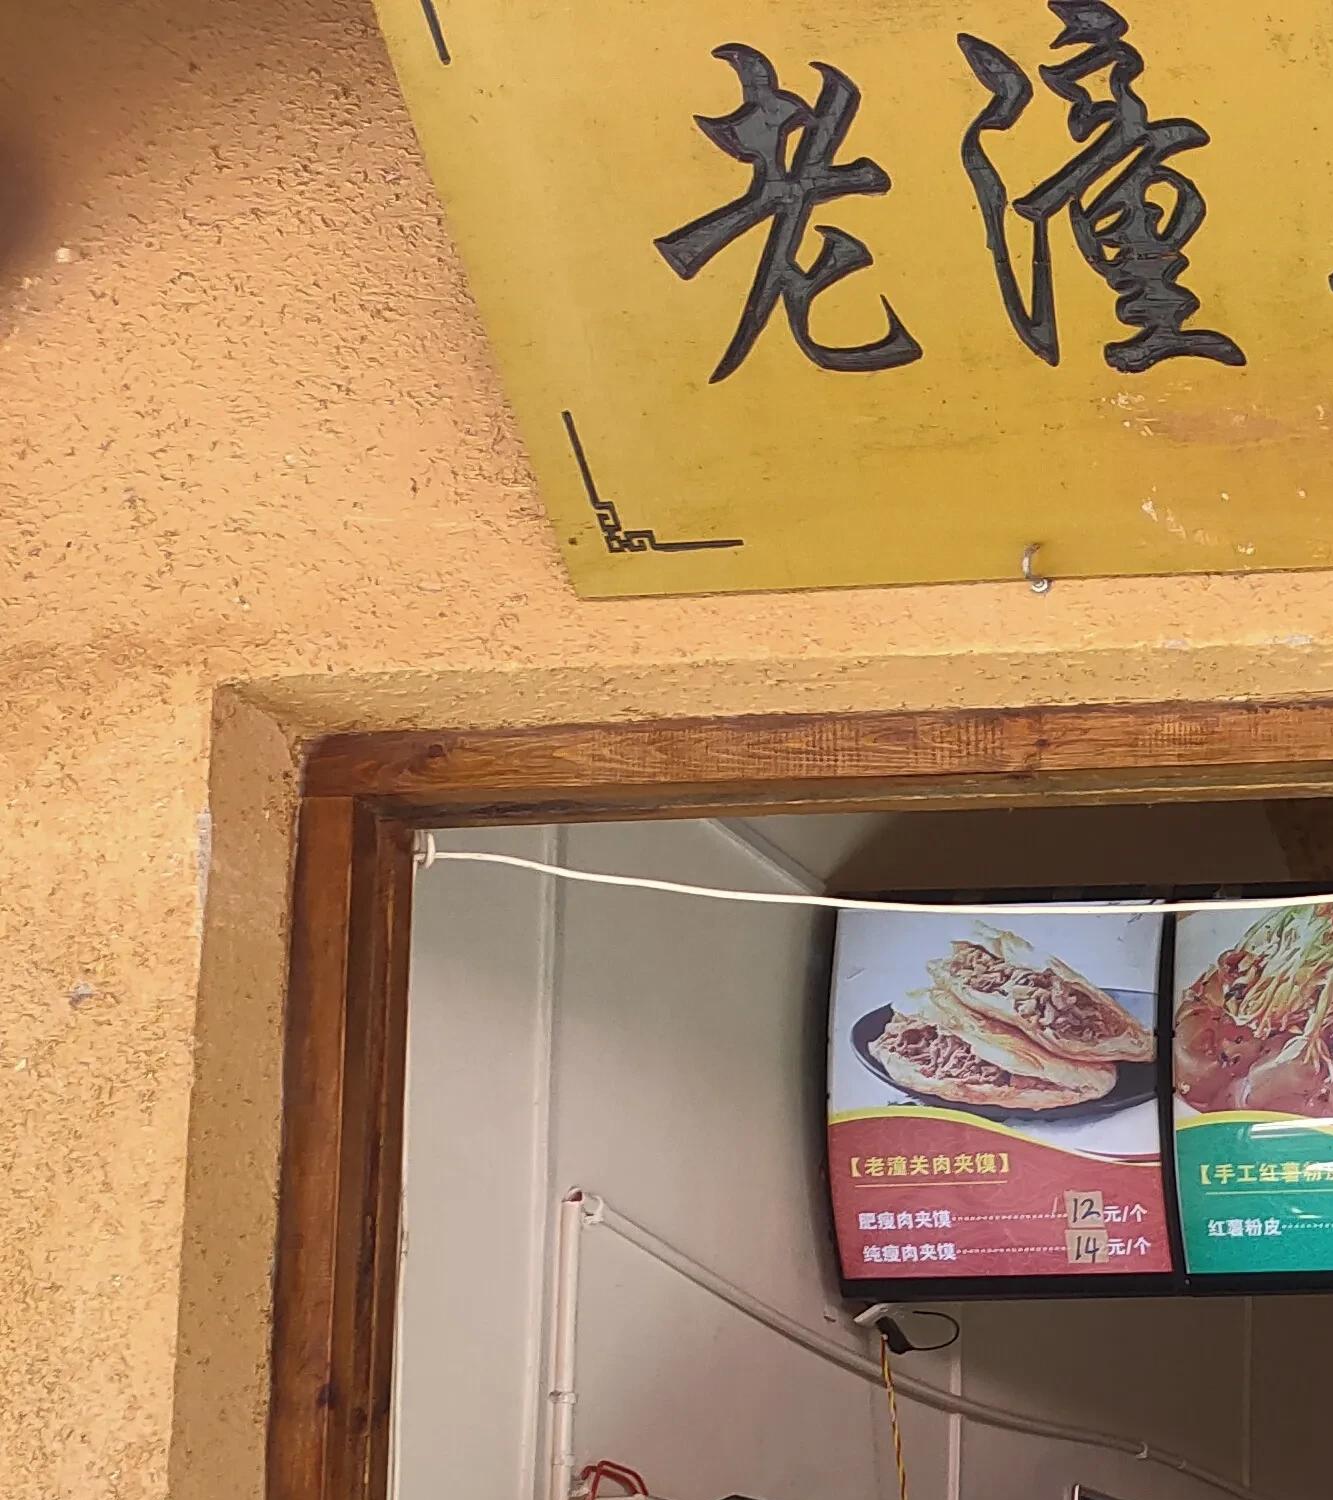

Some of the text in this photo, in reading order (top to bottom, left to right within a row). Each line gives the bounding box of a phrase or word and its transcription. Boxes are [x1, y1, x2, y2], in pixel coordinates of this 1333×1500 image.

[858, 1209, 952, 1231] 肥瘦肉夹馍
[1207, 1217, 1283, 1237] 红薯粉皮
[862, 1242, 957, 1264] 纯瘦肉夹馍
